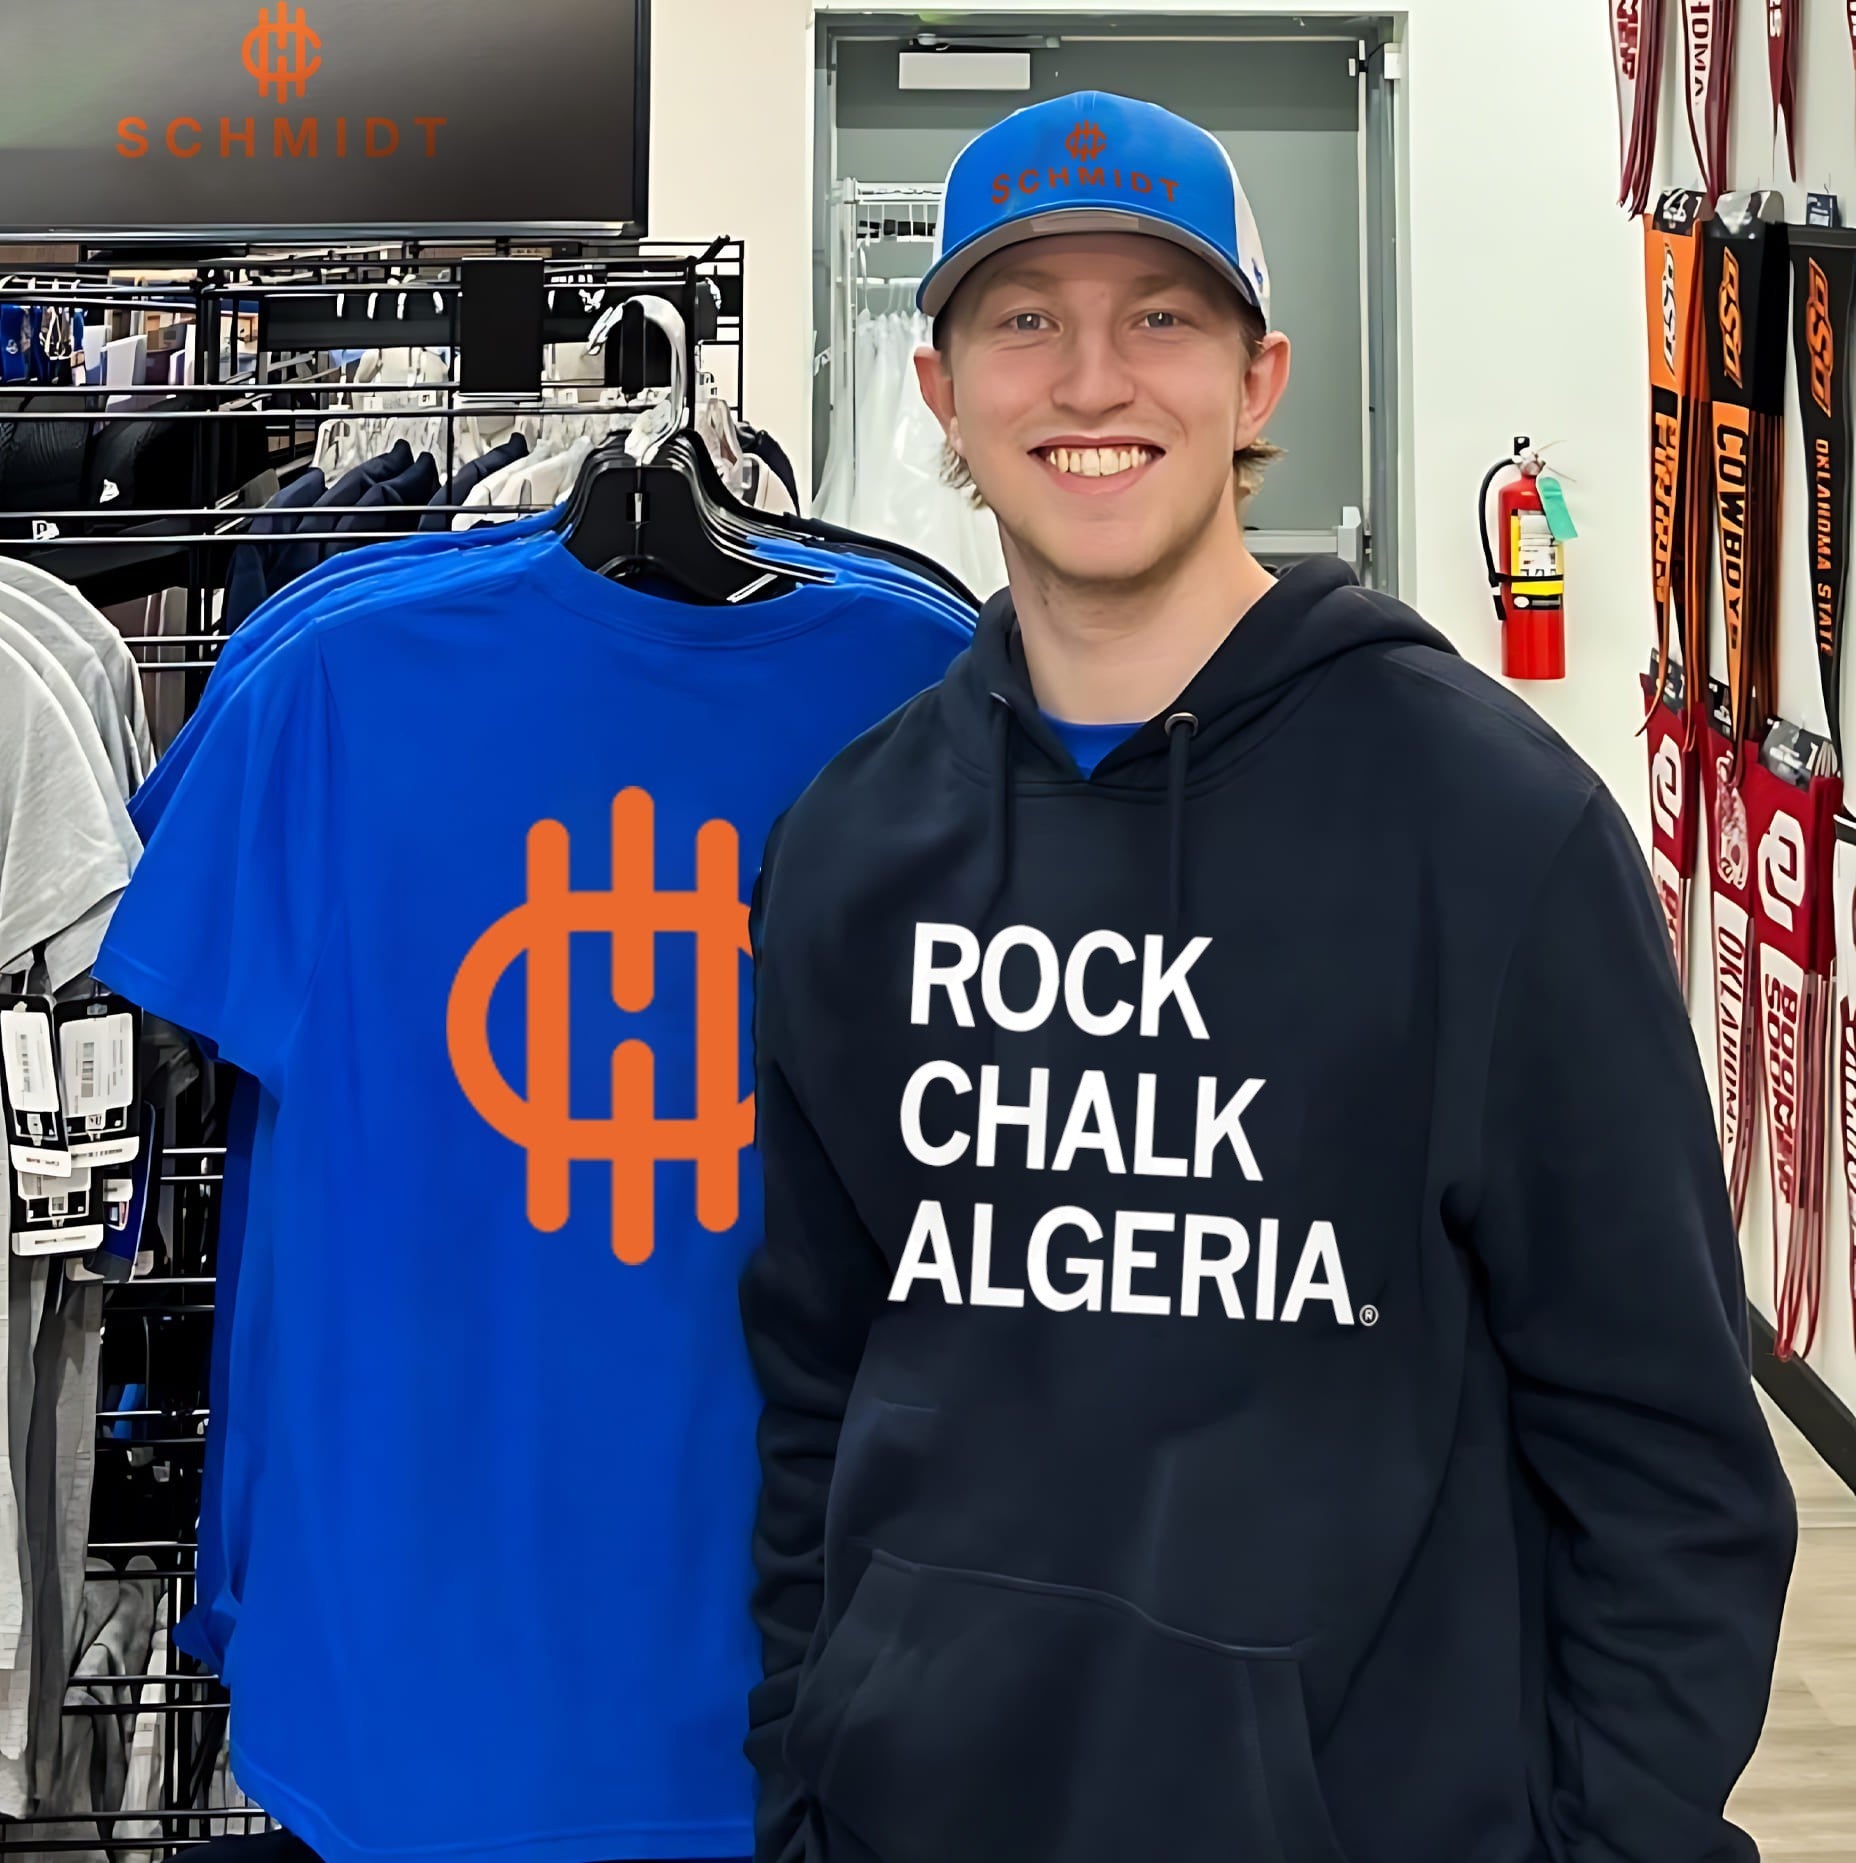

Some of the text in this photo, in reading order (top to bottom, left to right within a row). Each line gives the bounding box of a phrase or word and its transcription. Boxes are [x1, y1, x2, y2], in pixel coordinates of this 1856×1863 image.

[115, 117, 448, 159] SCHMIDT
[991, 166, 1179, 205] SCHMIDT
[910, 921, 1214, 1040] ROCK
[899, 1059, 1267, 1182] CHALK
[887, 1199, 1355, 1326] ALGERIA
